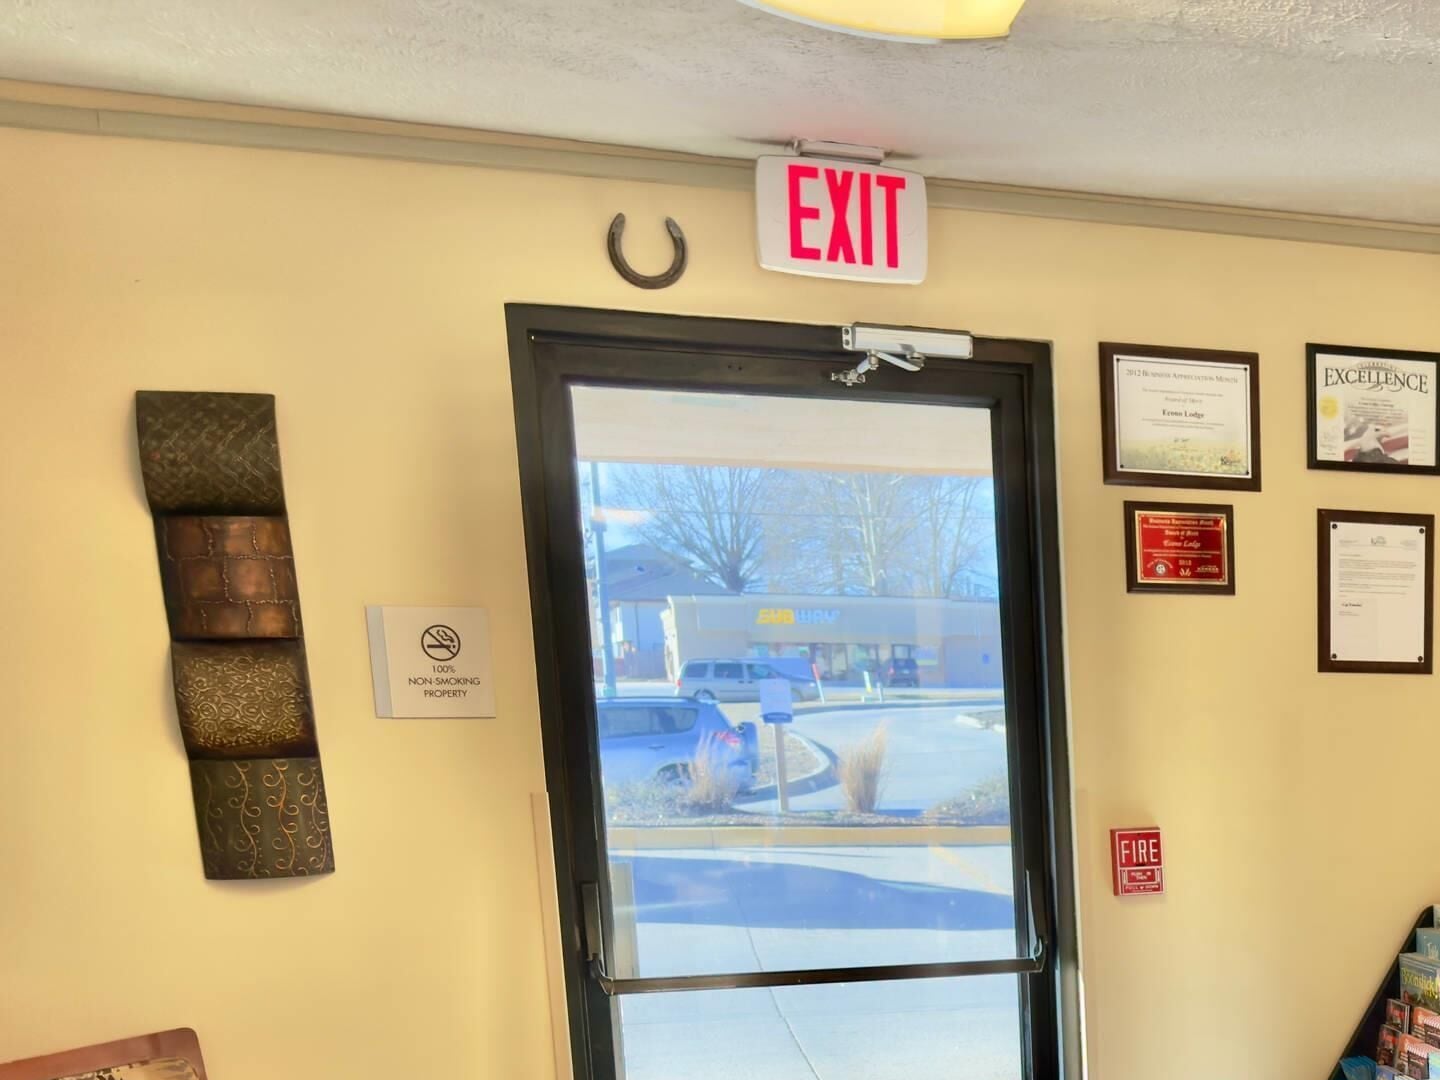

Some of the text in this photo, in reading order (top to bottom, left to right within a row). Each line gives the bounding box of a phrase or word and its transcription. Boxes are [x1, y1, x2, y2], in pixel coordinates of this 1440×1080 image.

[788, 165, 905, 268] EXIT
[1324, 367, 1428, 394] EXCELLENCE
[756, 608, 840, 625] SUBWAY
[432, 664, 457, 674] 100%
[408, 677, 481, 686] NON-SMOKING
[424, 689, 468, 698] PROPERTY
[1121, 839, 1159, 864] FIRE
